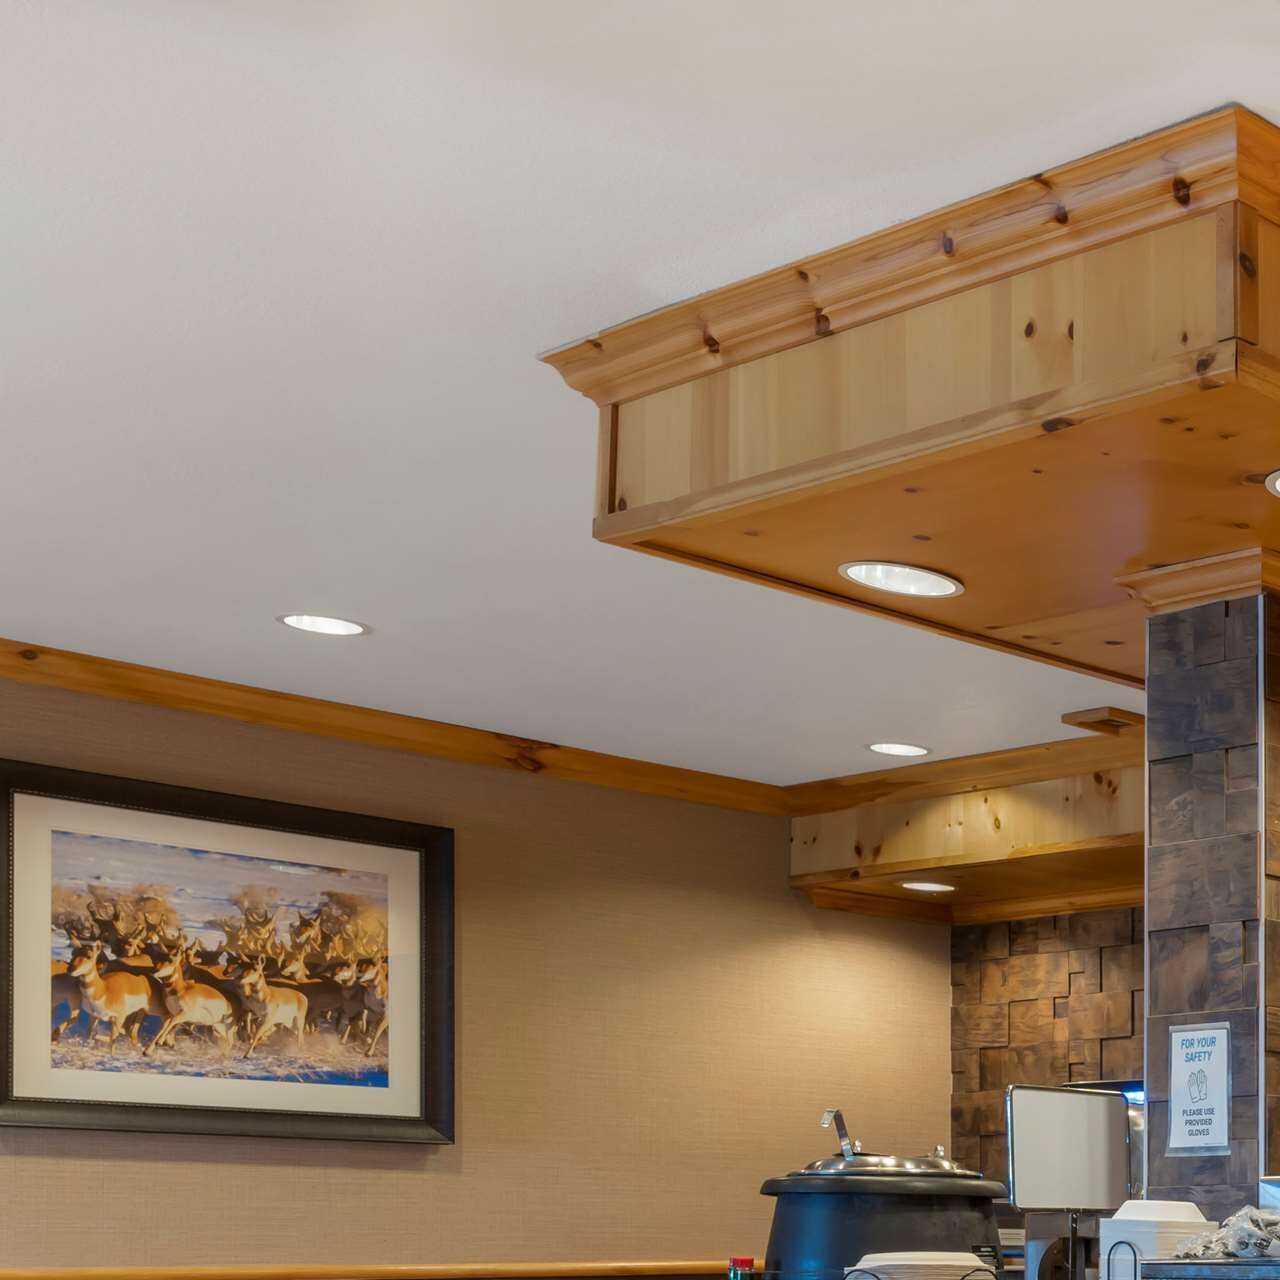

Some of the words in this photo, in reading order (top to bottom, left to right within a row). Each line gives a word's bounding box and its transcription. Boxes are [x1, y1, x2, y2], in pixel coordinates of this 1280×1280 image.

[1181, 1038, 1195, 1049] FOR
[1196, 1036, 1217, 1048] YOUR
[1184, 1051, 1213, 1062] SAFETY
[1182, 1108, 1203, 1117] PLEASE
[1203, 1107, 1215, 1115] USE
[1184, 1118, 1213, 1126] PROVIDED
[1187, 1128, 1210, 1137] GLOVES
